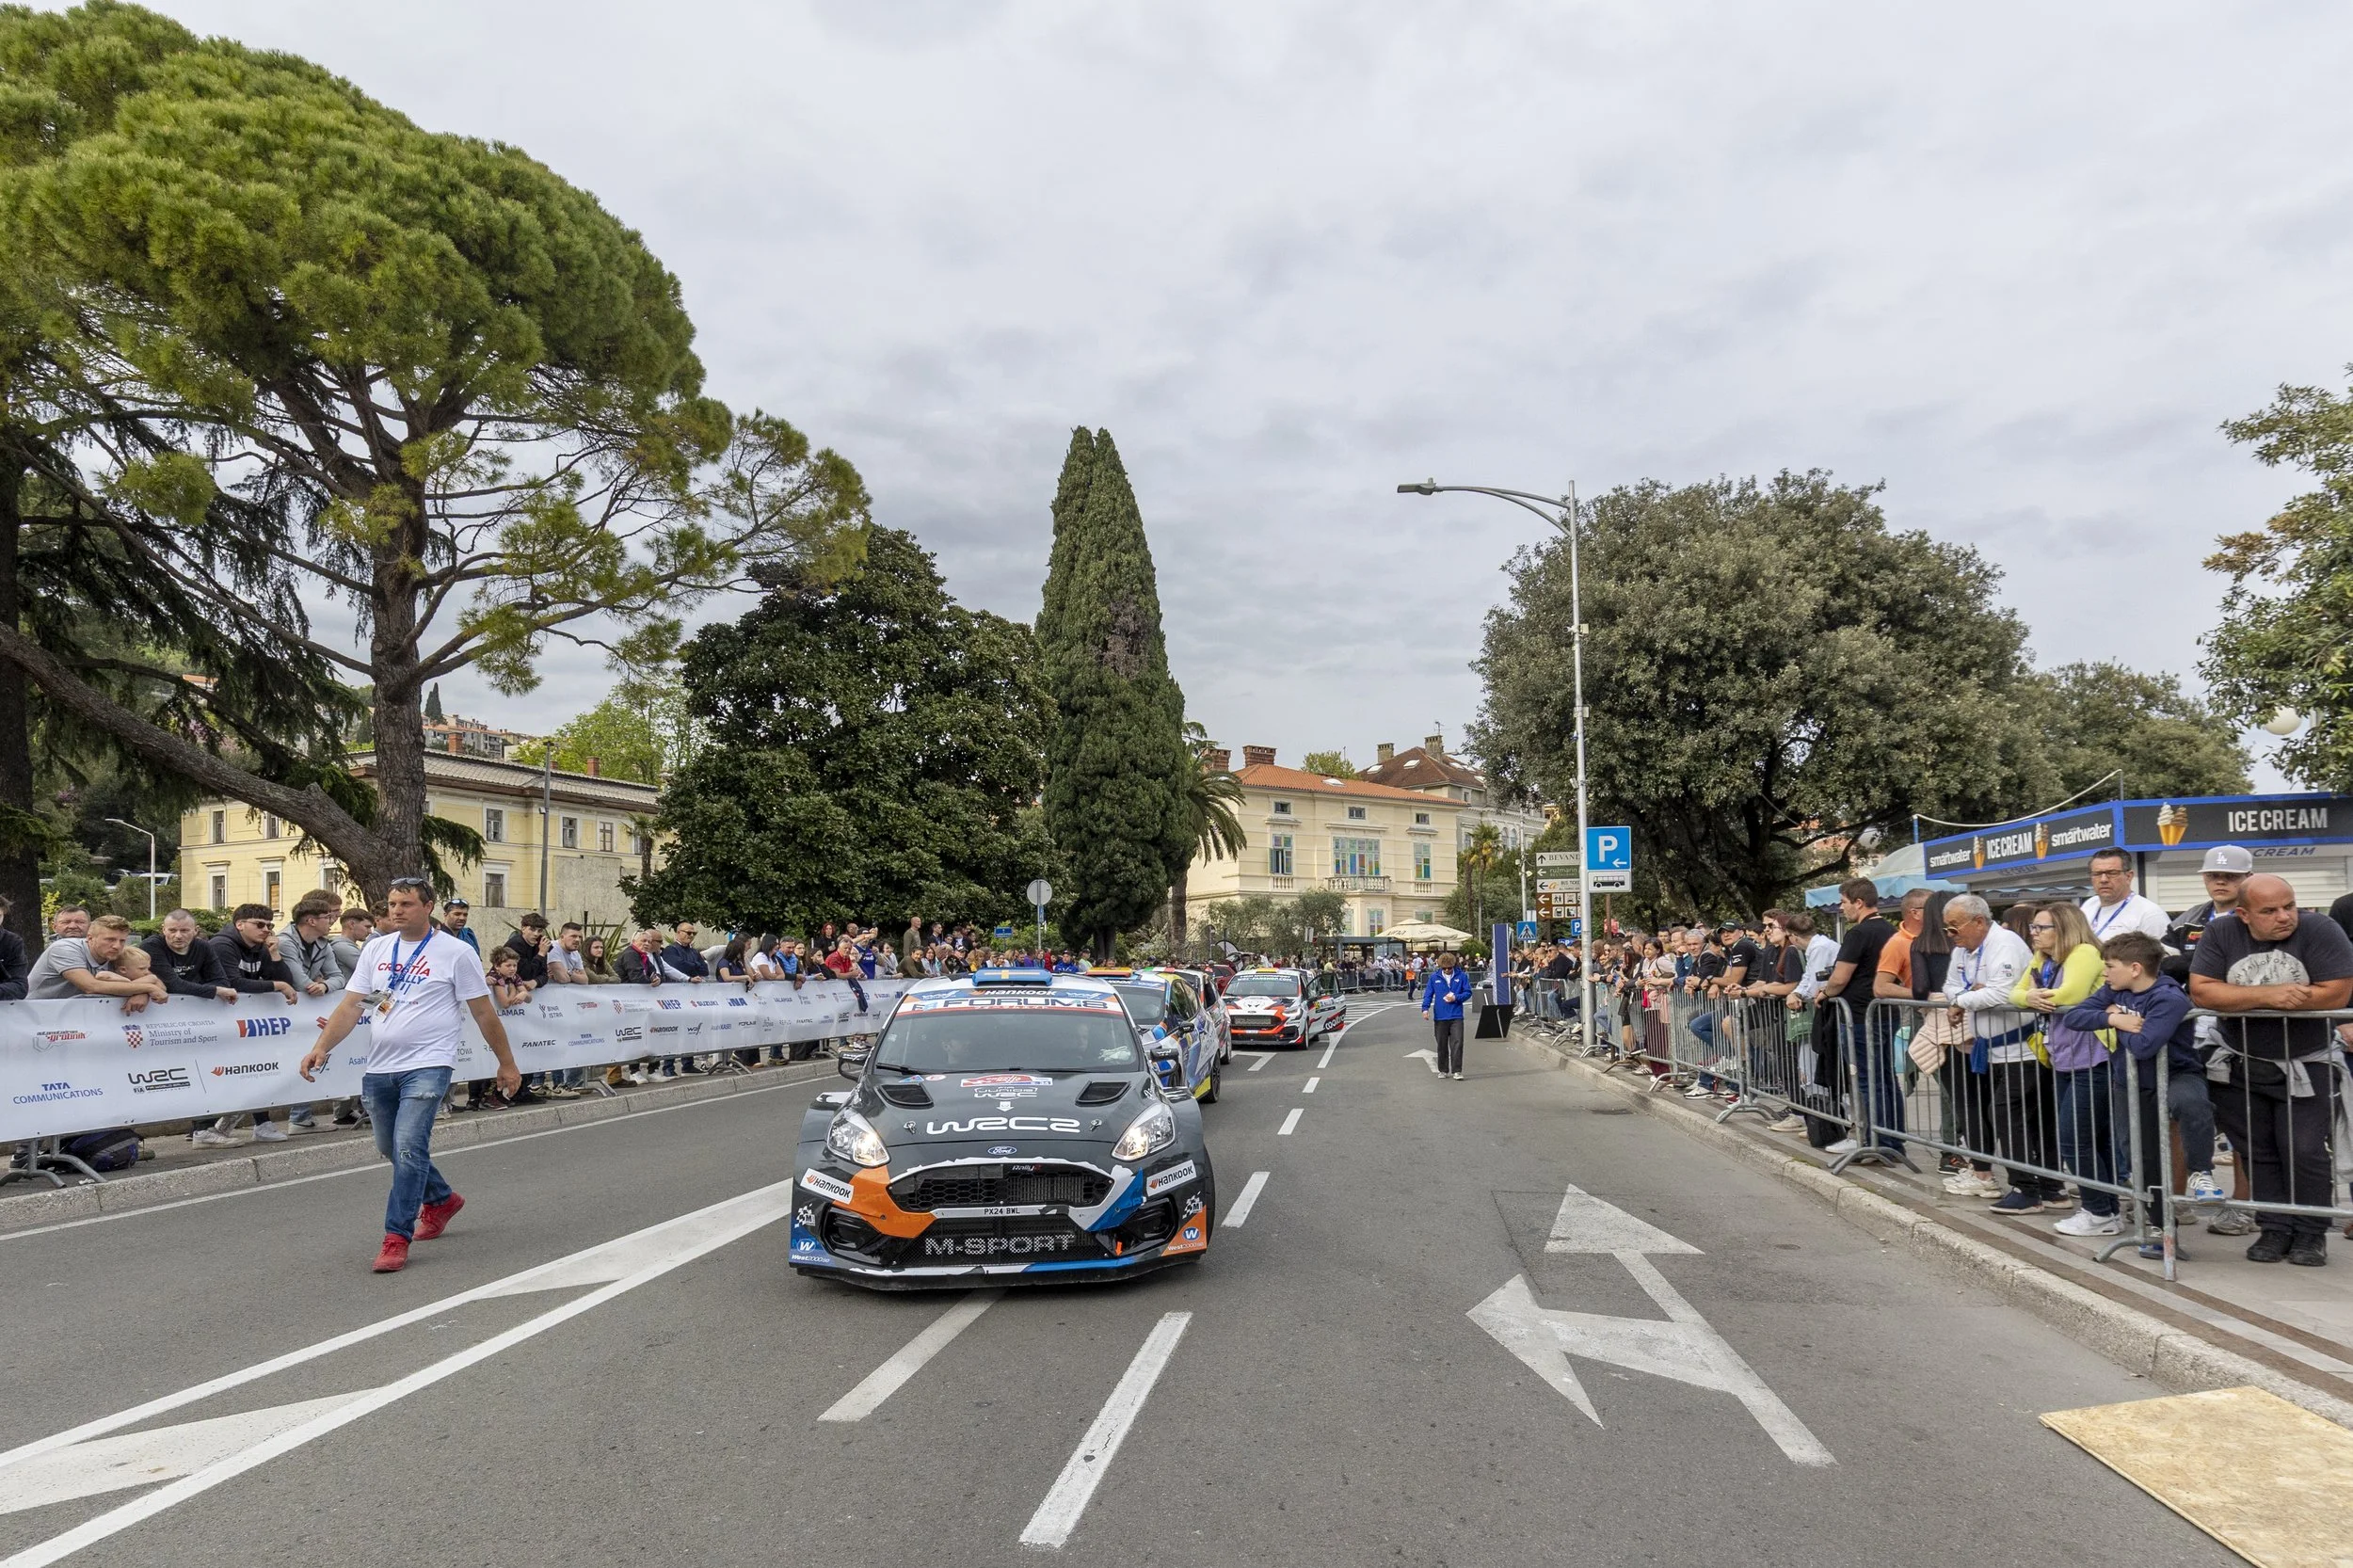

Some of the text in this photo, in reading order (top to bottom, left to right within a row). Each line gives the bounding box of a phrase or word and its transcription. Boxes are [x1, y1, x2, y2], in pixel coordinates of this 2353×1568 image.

[2228, 808, 2328, 832] ICE CREAM
[1598, 836, 1618, 862] P
[1929, 824, 2112, 868] smartwater ICE CREAM smartwater
[2253, 848, 2315, 857] CREAM
[2217, 852, 2228, 865] LA
[1574, 922, 1580, 933] P
[943, 998, 1108, 1009] FORUM8
[256, 1016, 292, 1037] HEP
[615, 1026, 642, 1037] WRC
[149, 1030, 182, 1038] Ministry
[150, 1037, 182, 1047] Tourism
[198, 1035, 217, 1044] Sport
[521, 1039, 556, 1048] FANATEC
[568, 1037, 605, 1047] COMMUNICATIONS
[128, 1067, 188, 1085] WRC
[41, 1082, 71, 1092] TATA
[13, 1088, 104, 1104] COMMUNICATIONS
[926, 1116, 1080, 1135] WRC2
[992, 1146, 1012, 1155] Ford
